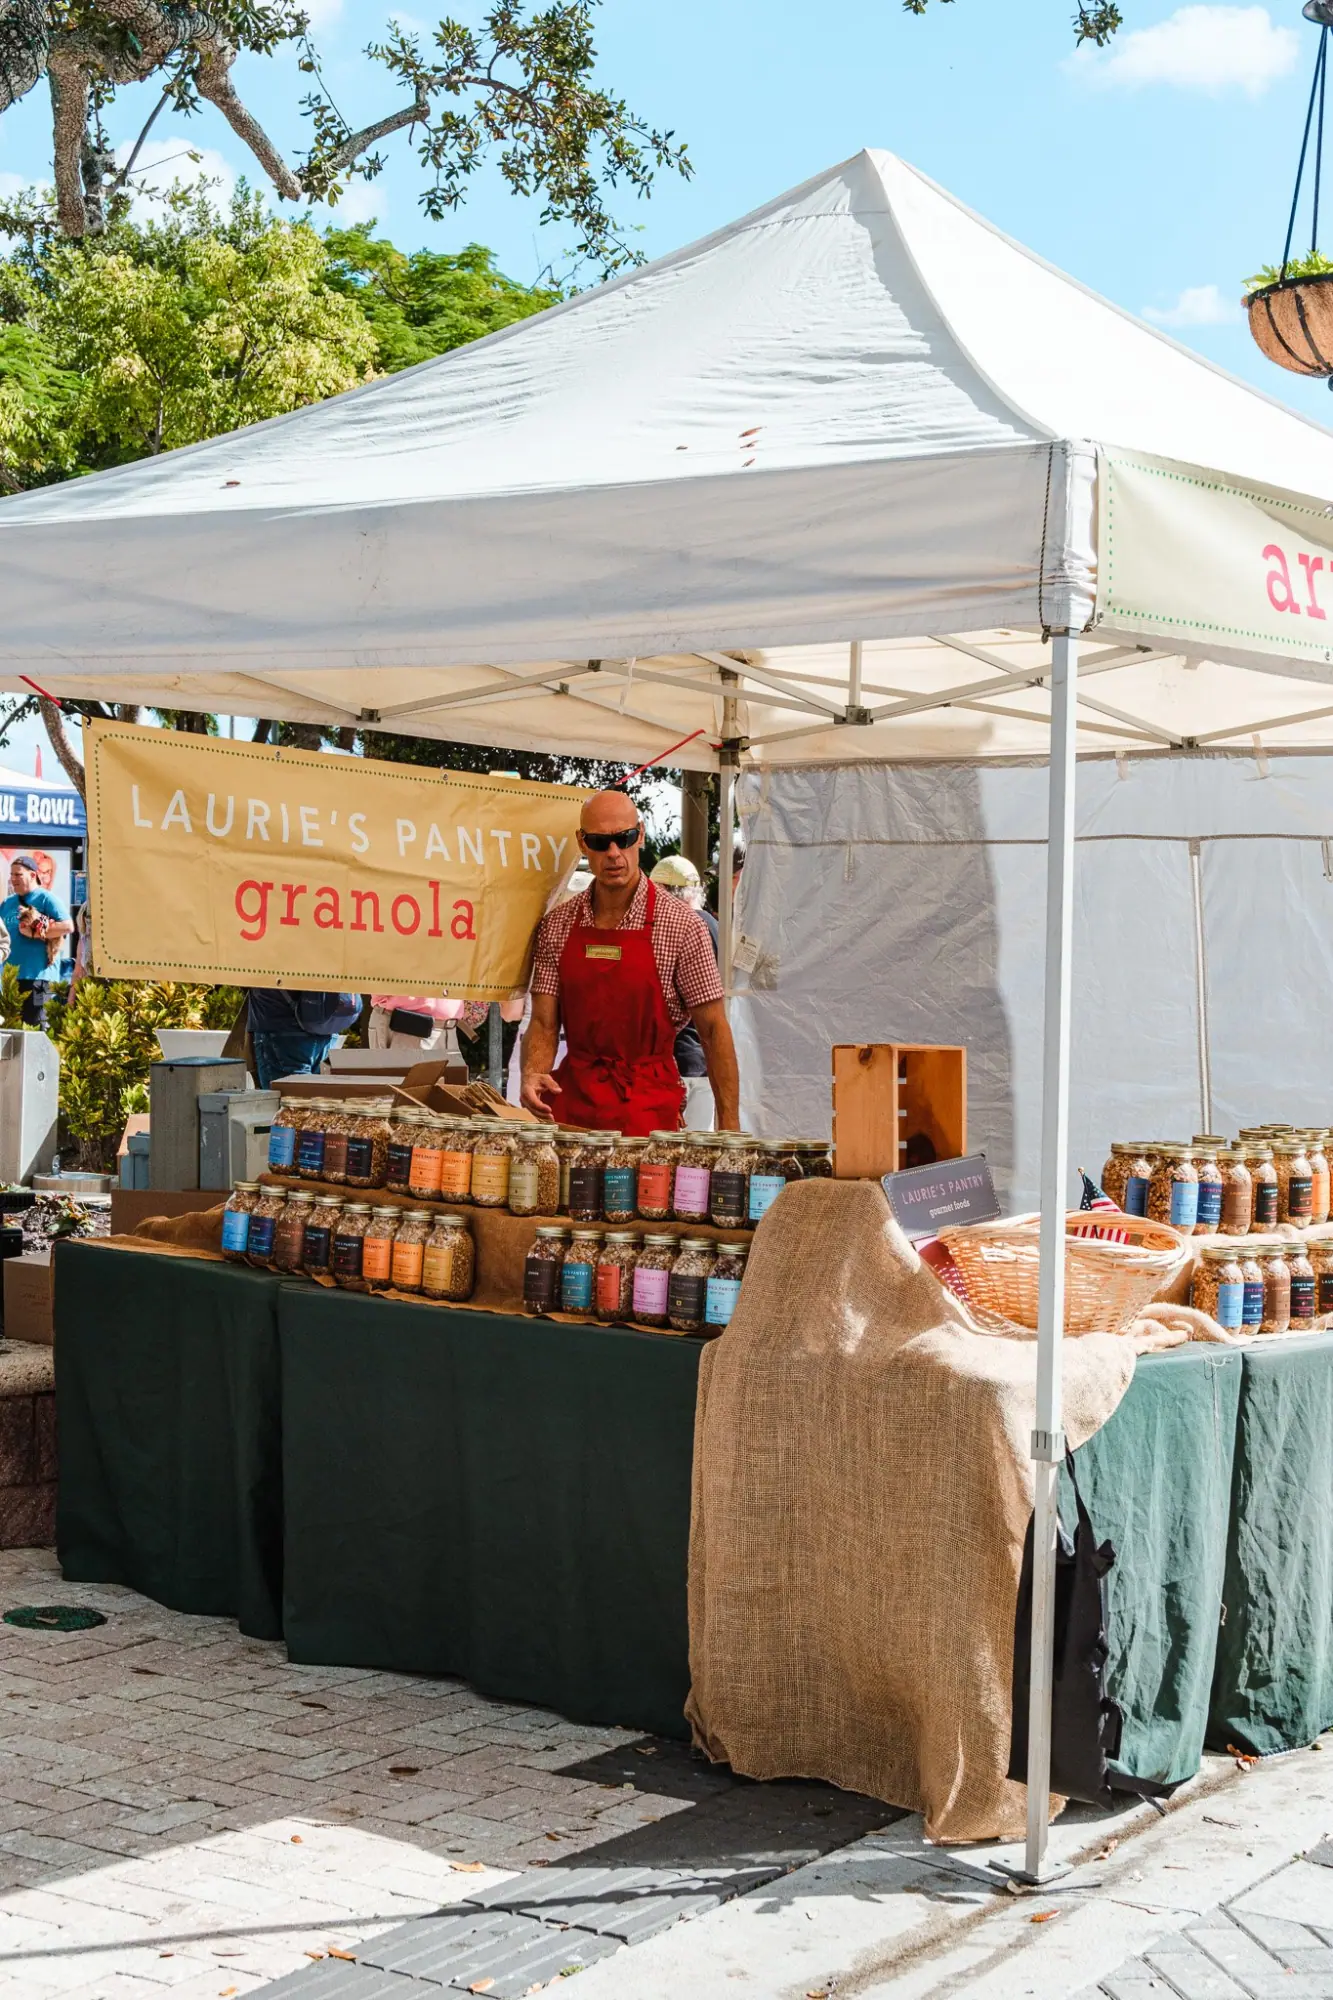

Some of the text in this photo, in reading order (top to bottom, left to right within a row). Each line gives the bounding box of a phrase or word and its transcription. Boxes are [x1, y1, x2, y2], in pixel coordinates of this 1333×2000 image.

[1262, 544, 1333, 620] ar
[27, 793, 79, 826] BOWL
[131, 784, 568, 873] LAURIE'S PANTRY
[234, 879, 476, 941] granola
[901, 1173, 984, 1205] LAURIE'S PANTRY
[929, 1198, 970, 1219] gourmet foods
